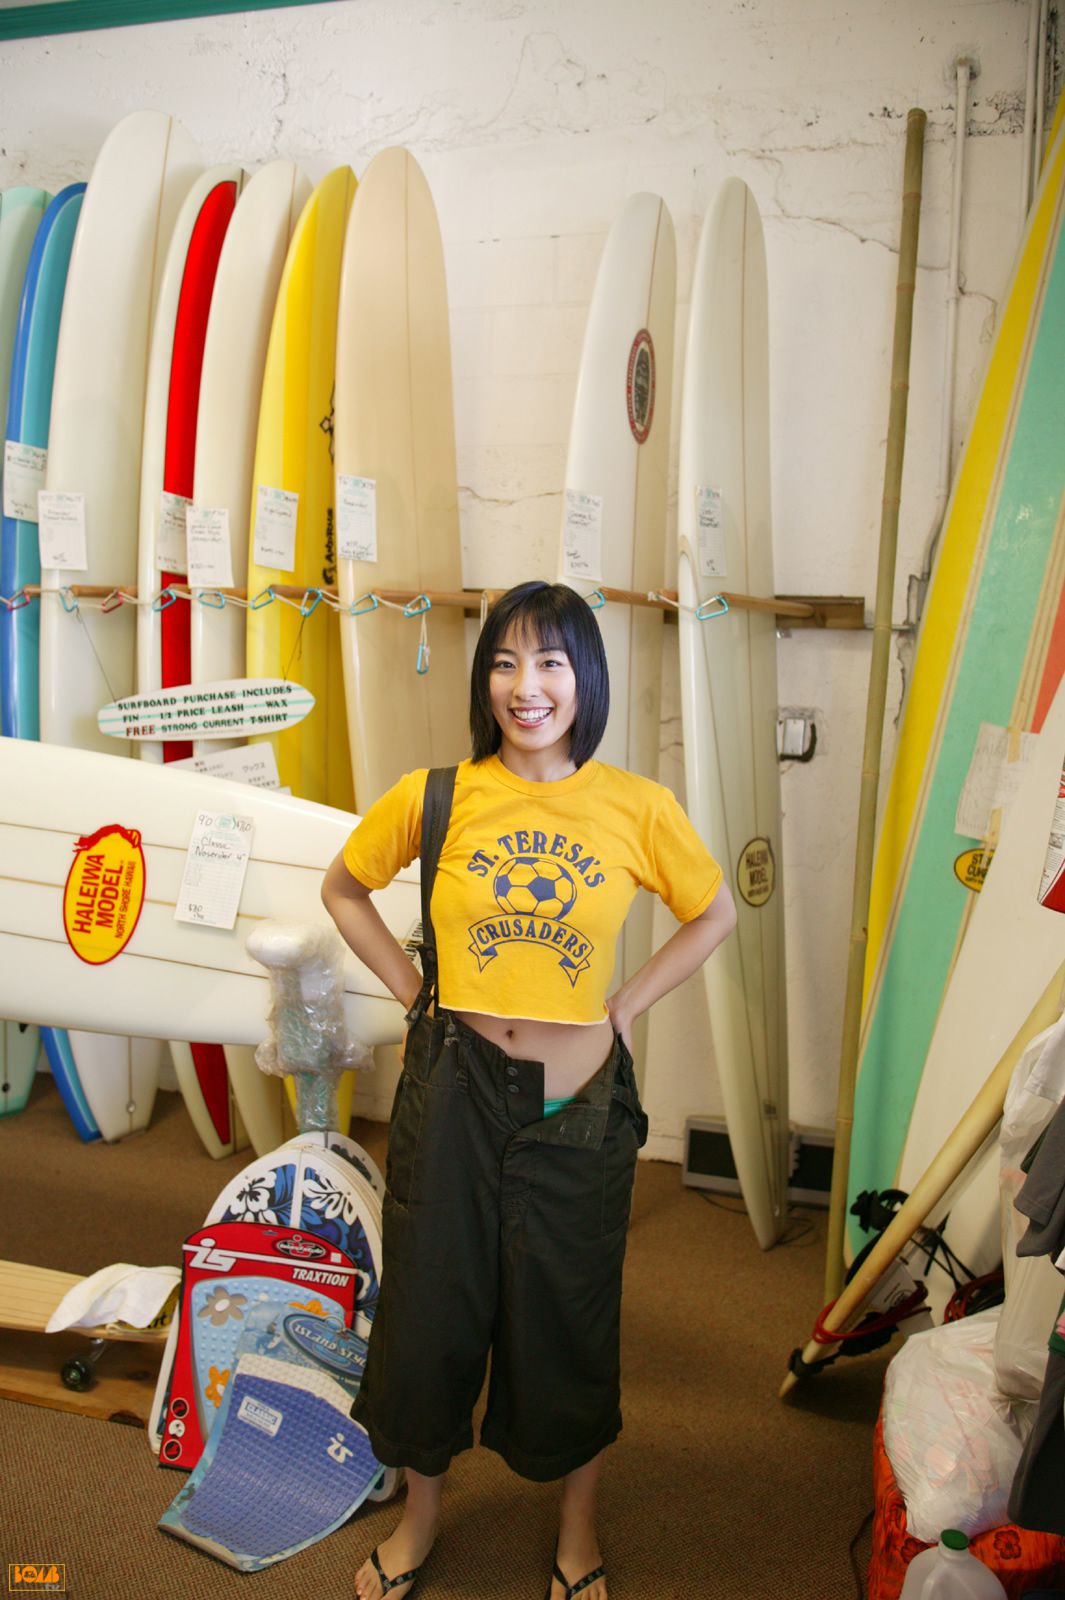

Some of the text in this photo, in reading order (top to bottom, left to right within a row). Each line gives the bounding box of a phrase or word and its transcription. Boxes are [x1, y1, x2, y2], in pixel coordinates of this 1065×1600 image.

[118, 685, 292, 711] SURFBOARD PURCHASE INCLUDES
[123, 714, 139, 723] FIN
[177, 707, 206, 718] PRICE
[211, 703, 244, 714] LEASH
[265, 699, 288, 708] WAX
[126, 725, 156, 737] FREE
[161, 722, 198, 733] STRONG
[203, 717, 244, 729] CURRENT
[250, 713, 288, 724] T-SHIRT
[467, 830, 606, 888] ST. TERESA'S
[72, 855, 105, 934] HALEIWA
[95, 865, 123, 928] MODEL
[119, 888, 131, 912] SHORE
[115, 913, 126, 939] NORTH
[476, 918, 588, 958] CRUSADERS
[292, 1267, 349, 1288] TRAXTION
